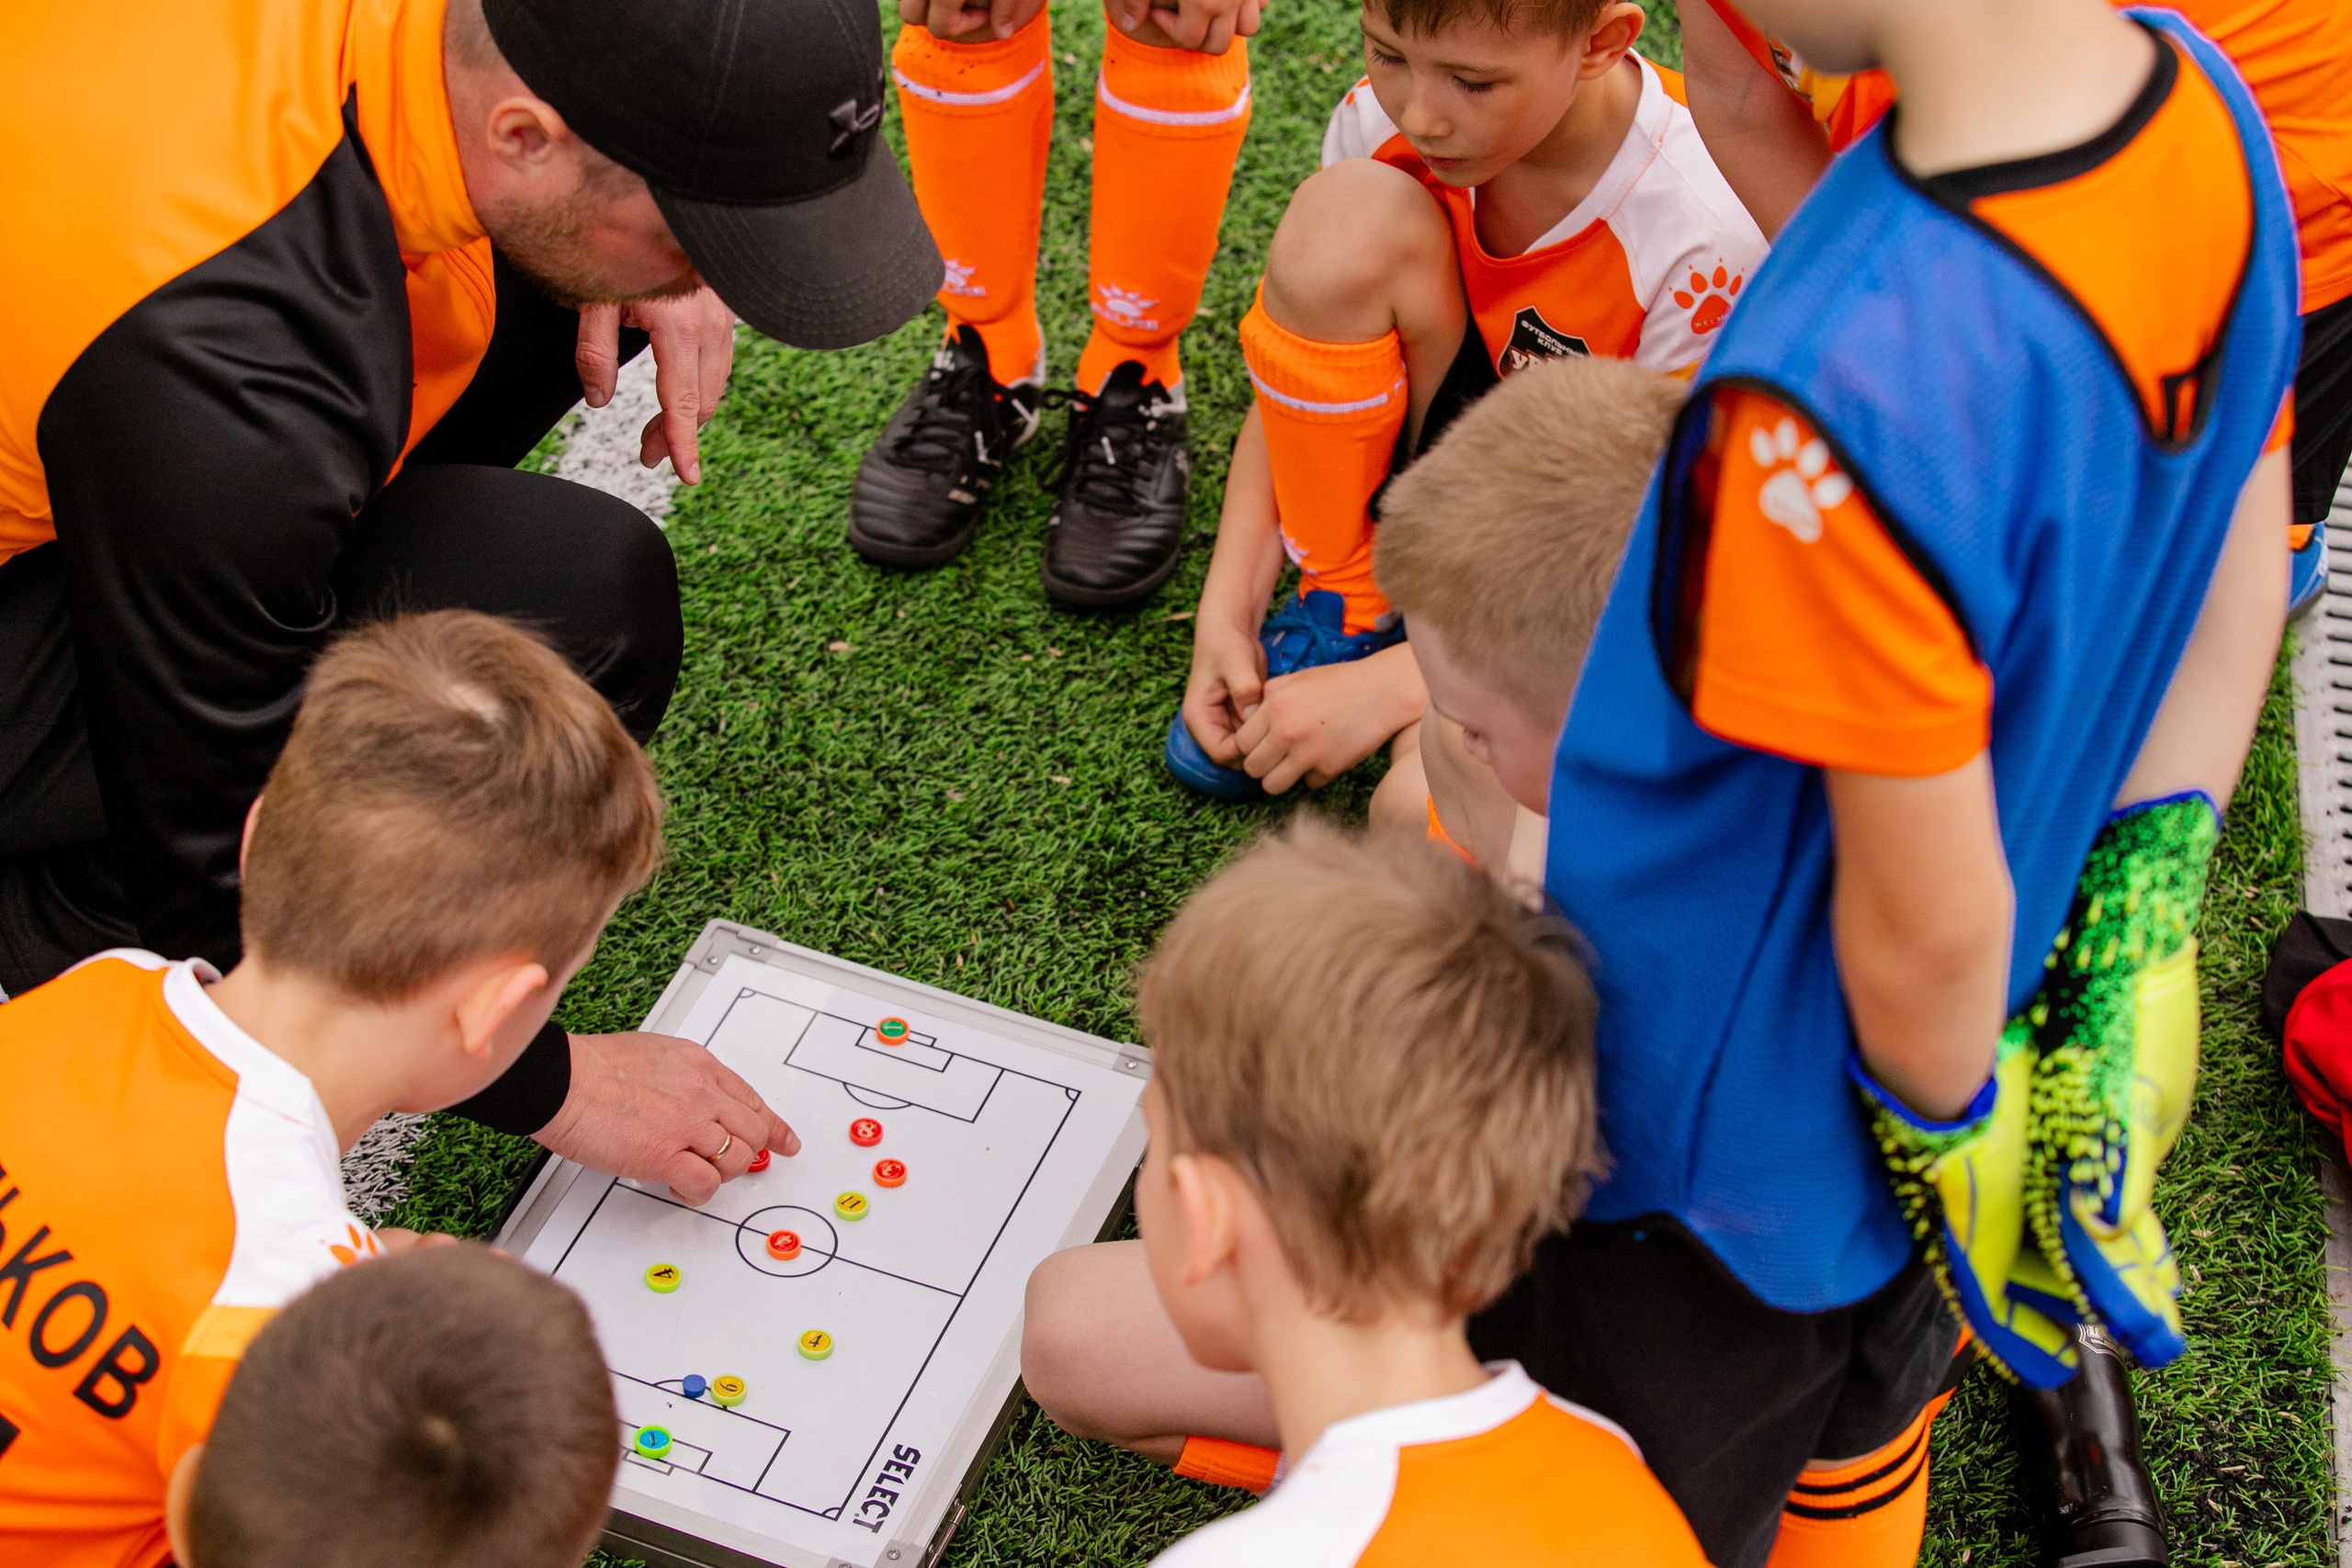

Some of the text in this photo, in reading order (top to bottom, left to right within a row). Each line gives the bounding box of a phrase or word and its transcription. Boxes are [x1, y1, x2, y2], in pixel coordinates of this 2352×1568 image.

[1695, 314, 1725, 329] KELM
[1536, 337, 1563, 355] КЛУБ
[857, 1121, 876, 1138] 8
[840, 1196, 862, 1210] 11
[652, 1267, 675, 1279] 4
[808, 1334, 823, 1348] 4
[853, 1443, 922, 1534] SELECT
